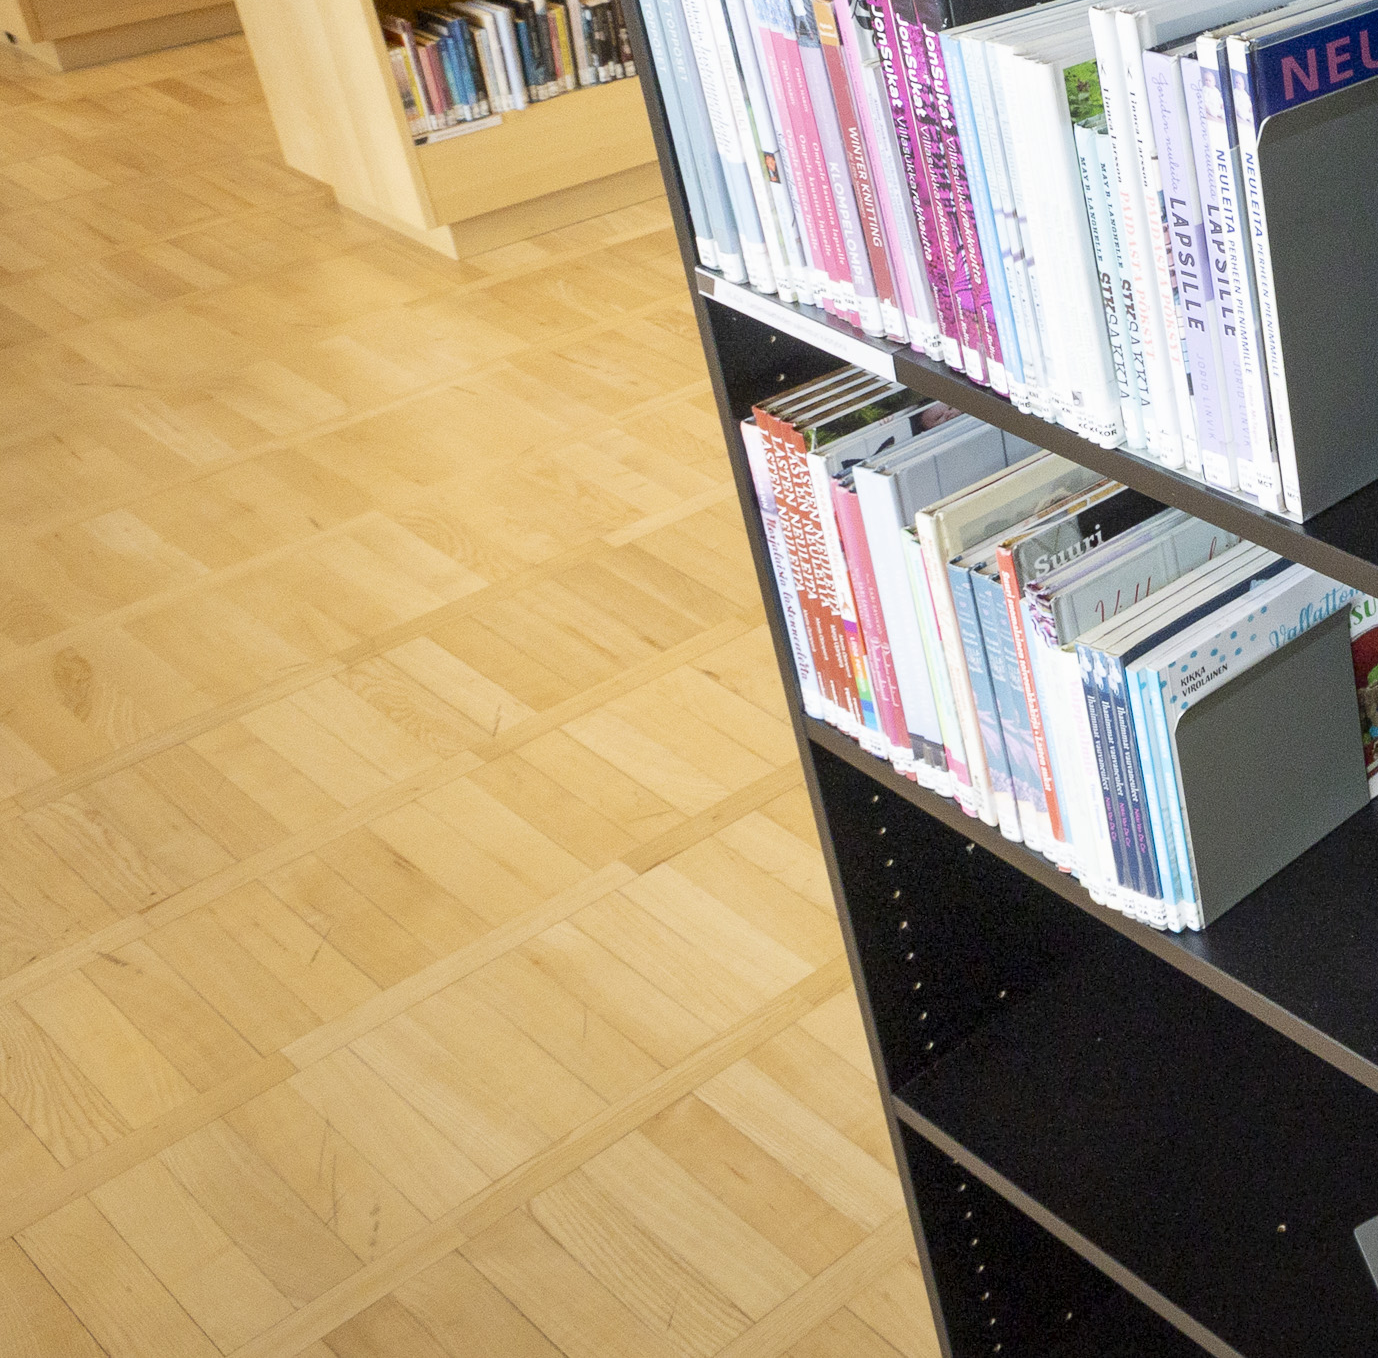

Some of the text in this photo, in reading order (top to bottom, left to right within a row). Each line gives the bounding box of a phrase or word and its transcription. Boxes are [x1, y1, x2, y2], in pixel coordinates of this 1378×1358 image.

[786, 130, 800, 166] Ompele
[796, 171, 811, 214] kaunista
[807, 219, 819, 250] lapselle
[799, 135, 814, 172] Ompele
[809, 178, 823, 216] kaunista
[819, 220, 832, 256] lapselle
[849, 128, 883, 247] WINTER KNITTING
[872, 5, 904, 106] JonSukat
[896, 117, 934, 260] Villasukkarakkautta
[897, 14, 928, 116] JonSukat
[921, 127, 958, 271] Villasukkarakkautta
[923, 24, 954, 127] JonSukat
[946, 139, 983, 284] Villasukkarakkautta
[813, 143, 827, 181] Ompele
[823, 188, 837, 225] kaunista
[833, 229, 846, 265] lapselle
[830, 162, 865, 285] KLOMPELOMPE
[1169, 197, 1206, 333] LAPSILLE
[1216, 150, 1253, 375] NEULEITA PERHEEN PIENIMMILLE
[1245, 153, 1280, 378] NEULEITA PERHEEN PIENIMMILLE
[1120, 192, 1143, 280] PAIDASTA
[1137, 290, 1157, 360] PÖKSYT
[1146, 195, 1168, 285] PAIDASTA
[1162, 294, 1182, 366] PÖKSYT
[1207, 204, 1237, 338] LAPSILLE
[766, 519, 791, 585] Norjalaisia
[771, 436, 797, 506] LASTEN
[789, 513, 819, 598] NEULEITA
[795, 451, 820, 521] LASTEN
[812, 529, 842, 615] NEULEITA
[1033, 523, 1103, 578] Suuri
[1001, 572, 1052, 792] Suuri suomalainen toivesukkakirja Lasten sukat
[1087, 695, 1101, 739] Ihanimmat
[1102, 701, 1115, 744] Ihanimmat
[1117, 707, 1130, 750] Ihanimmat
[1179, 665, 1207, 687] KIKKA
[1181, 663, 1229, 698] VIROLAINEN
